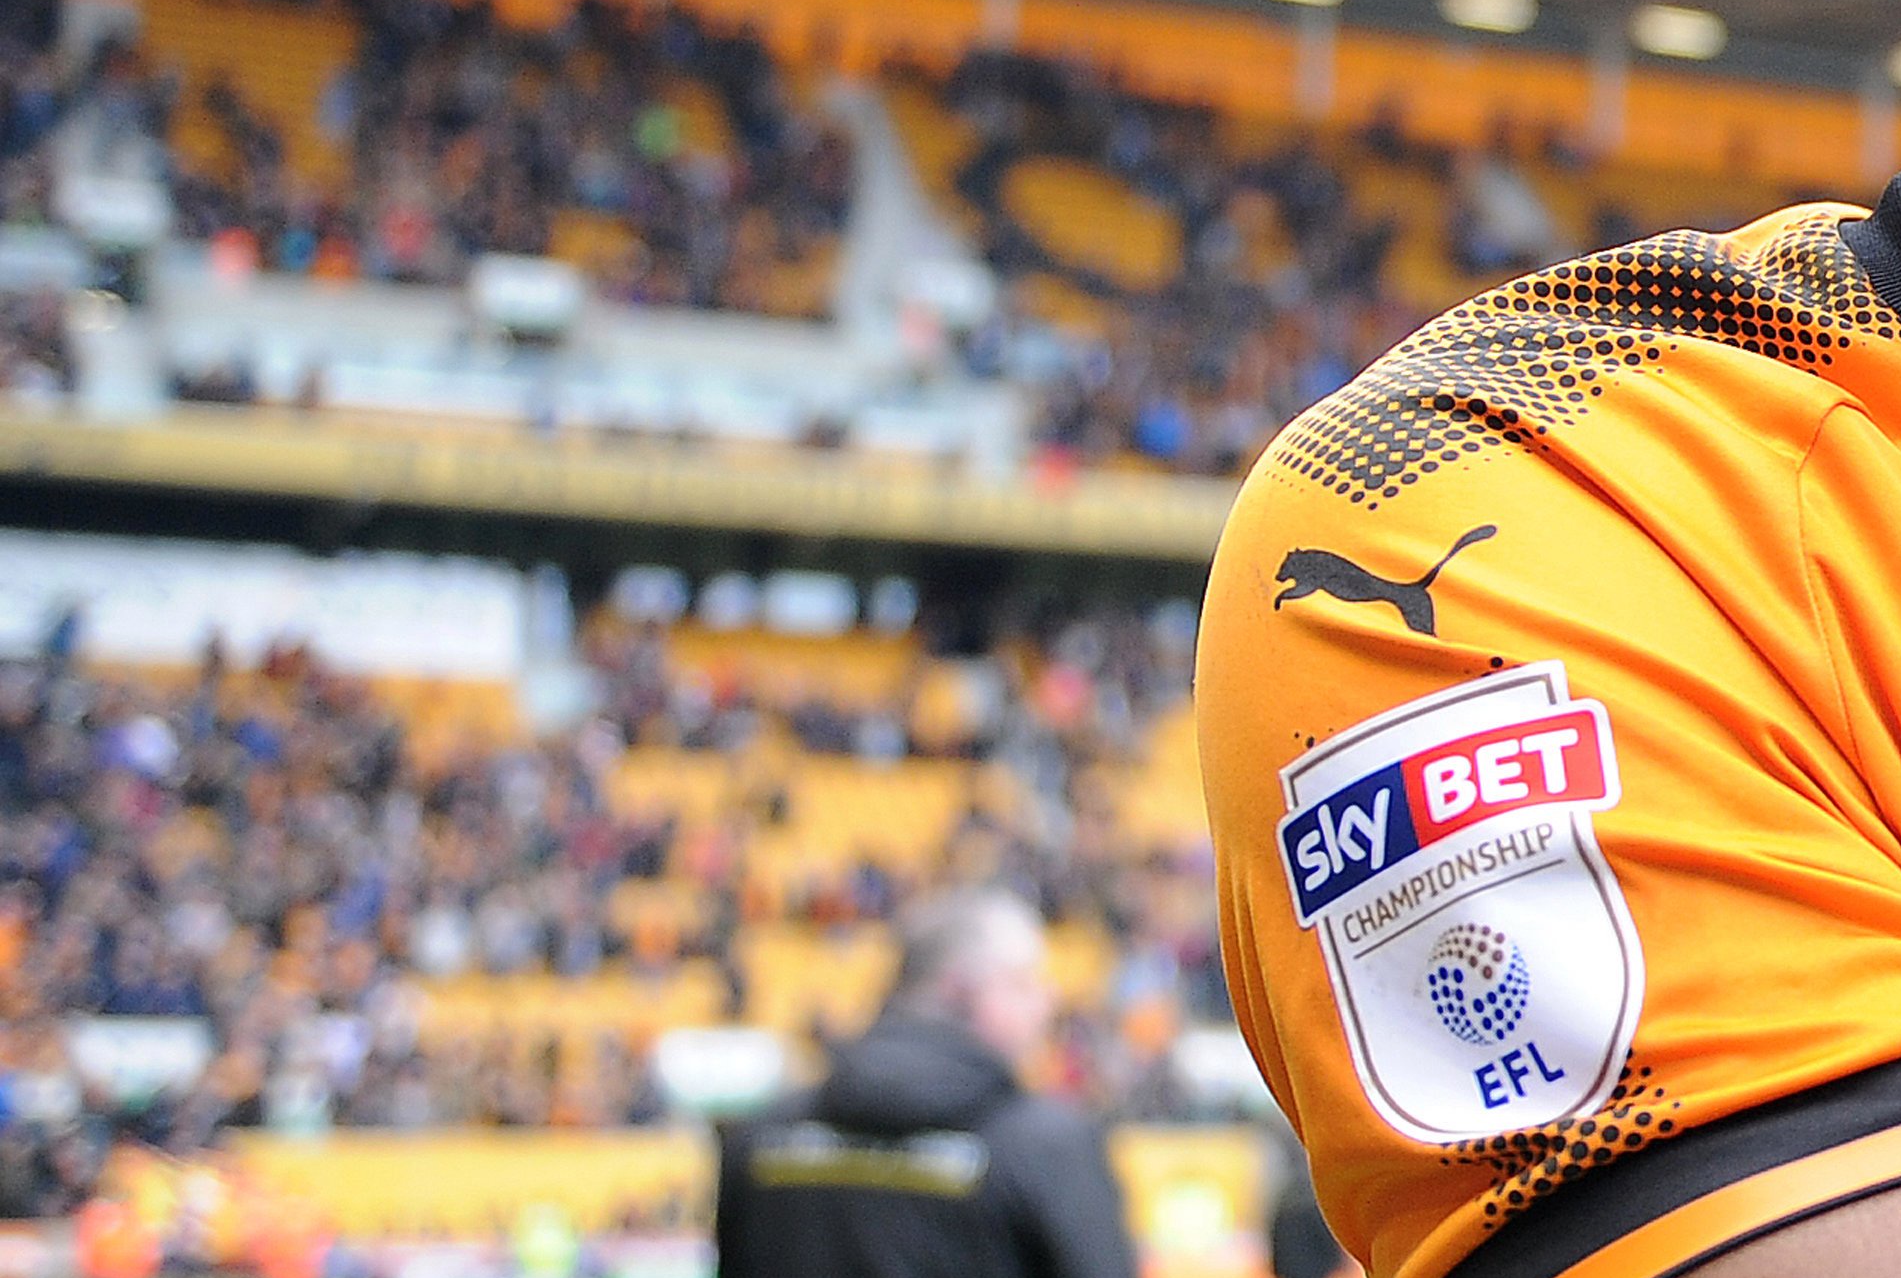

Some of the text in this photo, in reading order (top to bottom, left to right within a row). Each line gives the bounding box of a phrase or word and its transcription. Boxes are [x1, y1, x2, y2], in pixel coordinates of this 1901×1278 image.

[1422, 727, 1579, 825] BET
[1342, 823, 1554, 945] CHAMPIONSHIP
[1474, 1042, 1565, 1109] EFL
